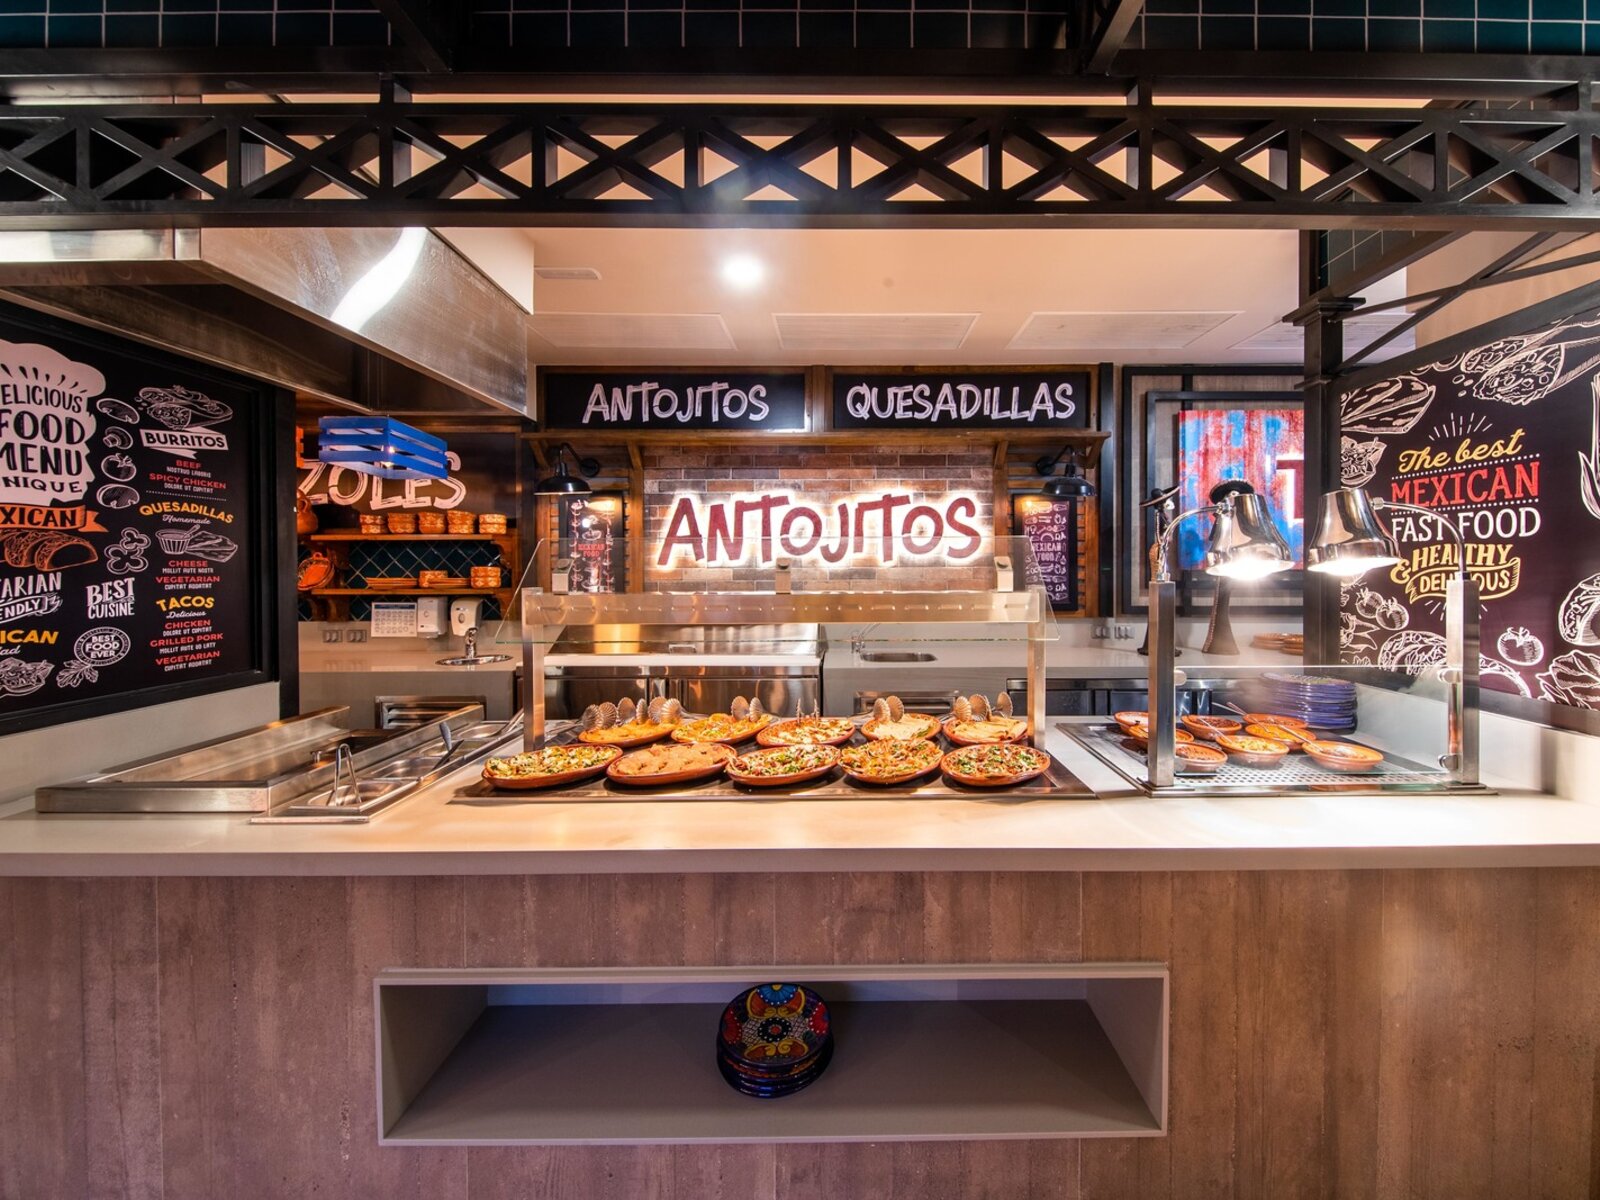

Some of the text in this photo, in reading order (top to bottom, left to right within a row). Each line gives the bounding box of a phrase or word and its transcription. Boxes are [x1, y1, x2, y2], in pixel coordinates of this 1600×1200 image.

[582, 381, 770, 424] ANTOJITOS
[846, 382, 1076, 422] QUESADILLAS
[144, 432, 225, 448] BURRITOS
[1398, 428, 1526, 473] The best
[175, 459, 202, 469] BEEF
[149, 472, 227, 490] SPICY CHICKEN
[1391, 461, 1540, 511] MEXICAN
[139, 501, 234, 523] QUESADILLAS
[162, 514, 212, 525] Homemade
[657, 494, 981, 565] ANTOJITOS
[1391, 506, 1541, 543] FAST FOOD
[168, 560, 208, 568] CHEESE
[1390, 558, 1412, 584] &
[0, 572, 61, 598] ARIAN
[155, 575, 220, 584] VEGETARIAN
[86, 577, 136, 606] BEST
[88, 602, 136, 619] CUISINE
[156, 595, 215, 612] TACOS
[166, 611, 206, 619] Delicious
[165, 620, 211, 630] CHICKEN
[85, 641, 119, 652] FOOD
[91, 634, 116, 643] BEST
[150, 633, 224, 648] GRILLED PORK
[90, 650, 116, 658] EVER
[155, 651, 220, 665] VEGETARIAN
